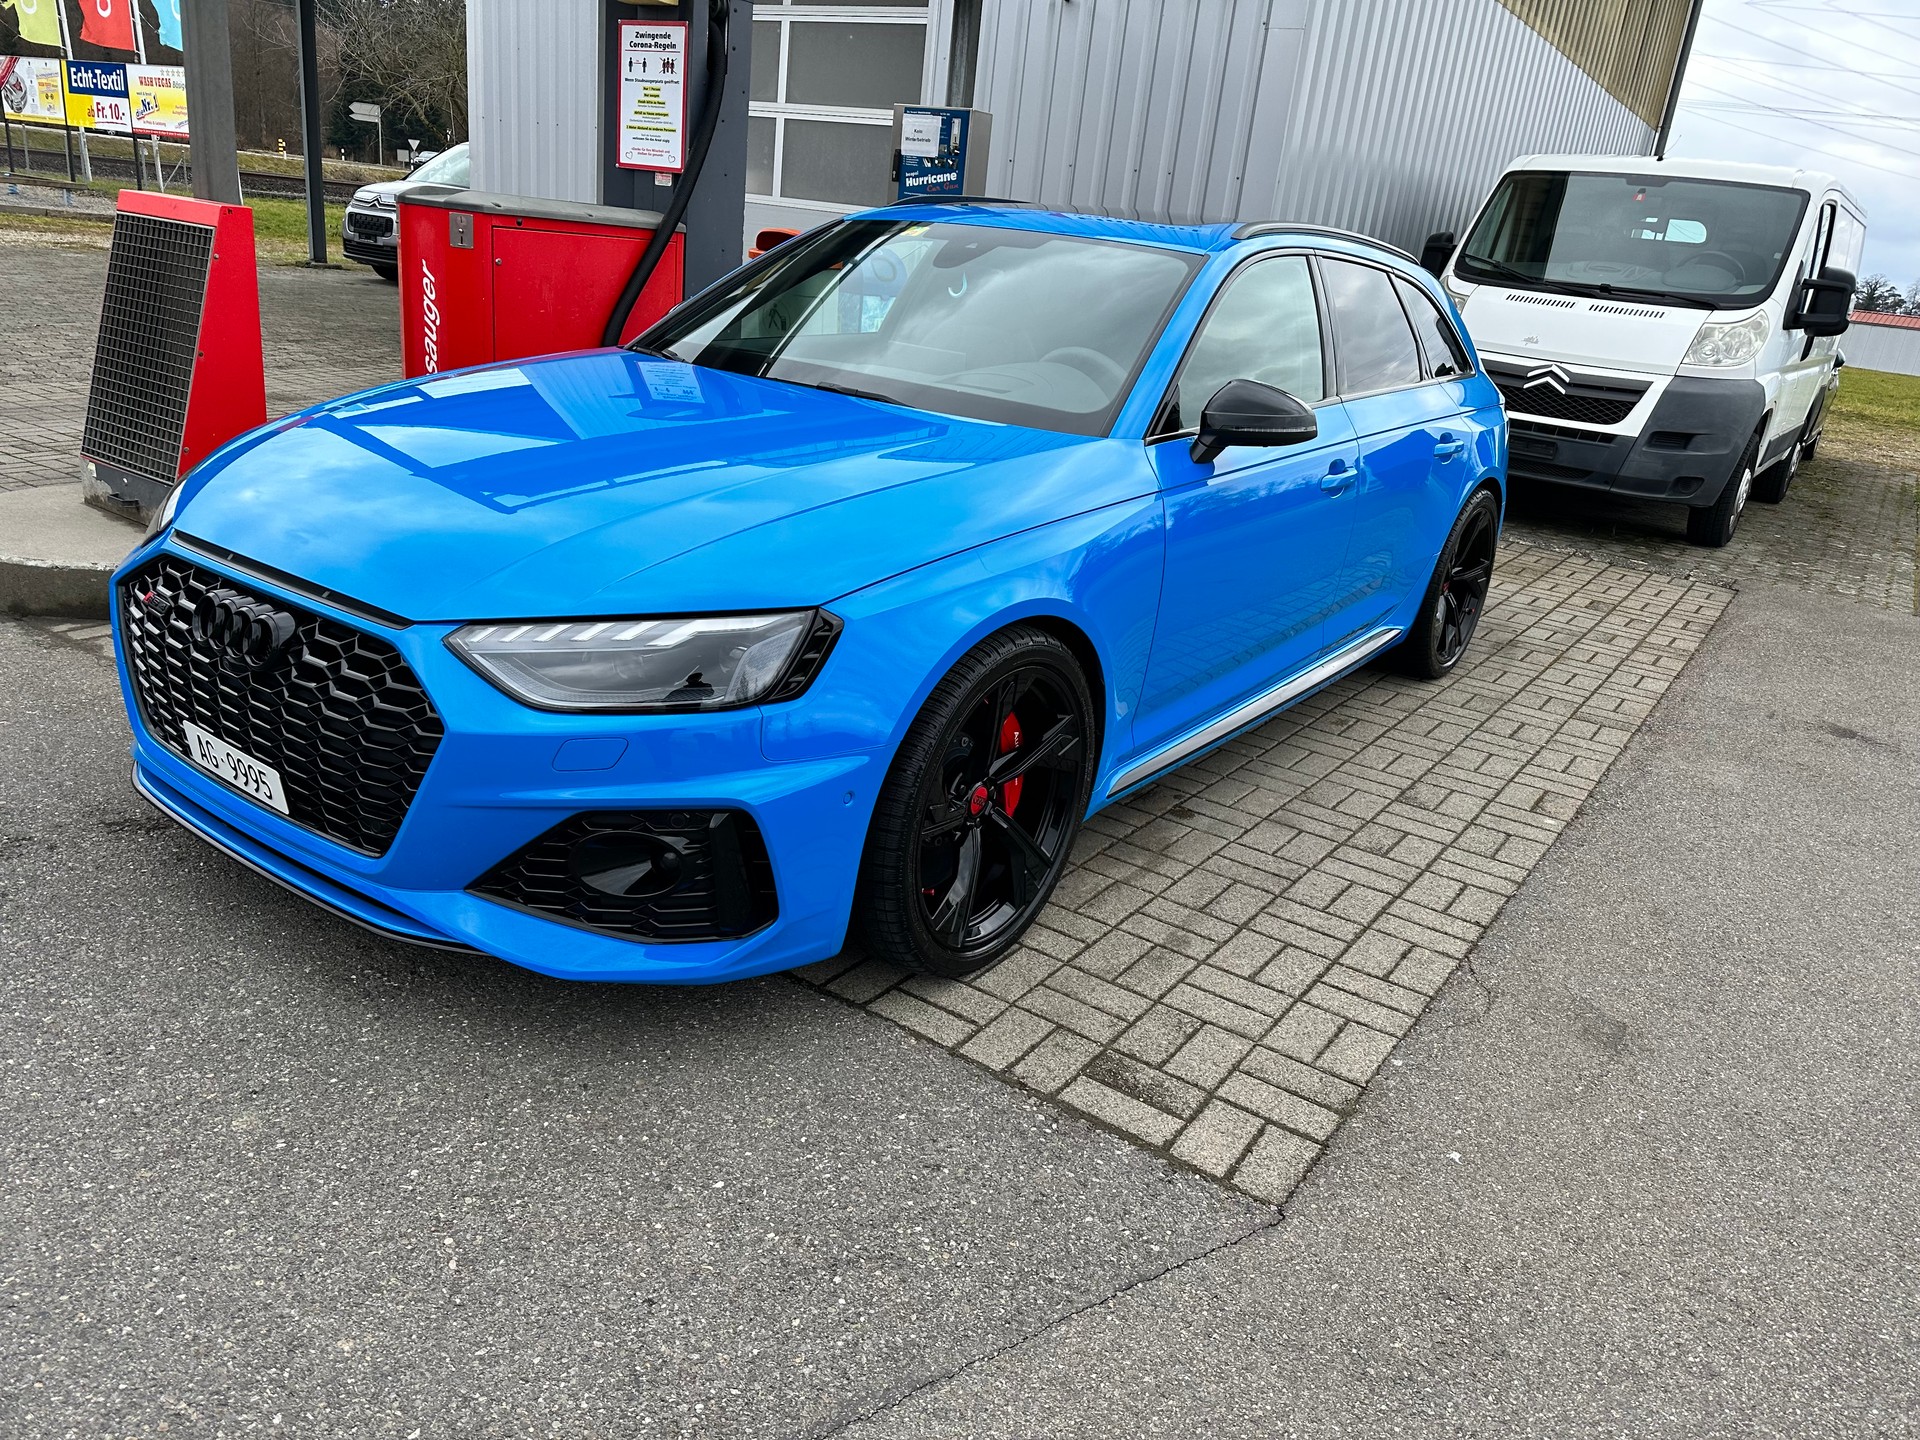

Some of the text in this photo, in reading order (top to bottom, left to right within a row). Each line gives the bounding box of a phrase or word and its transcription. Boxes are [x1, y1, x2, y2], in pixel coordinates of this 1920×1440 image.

[635, 31, 671, 41] Zwingende
[629, 41, 677, 51] Corona-Regeln
[70, 66, 125, 91] Echt-Textil
[138, 76, 154, 87] WASH
[154, 77, 172, 88] VEGAS
[87, 105, 95, 118] ab
[96, 101, 107, 119] Fr.
[905, 171, 957, 187] Hurricane
[421, 258, 441, 375] sauger
[197, 733, 274, 800] AG 9995
